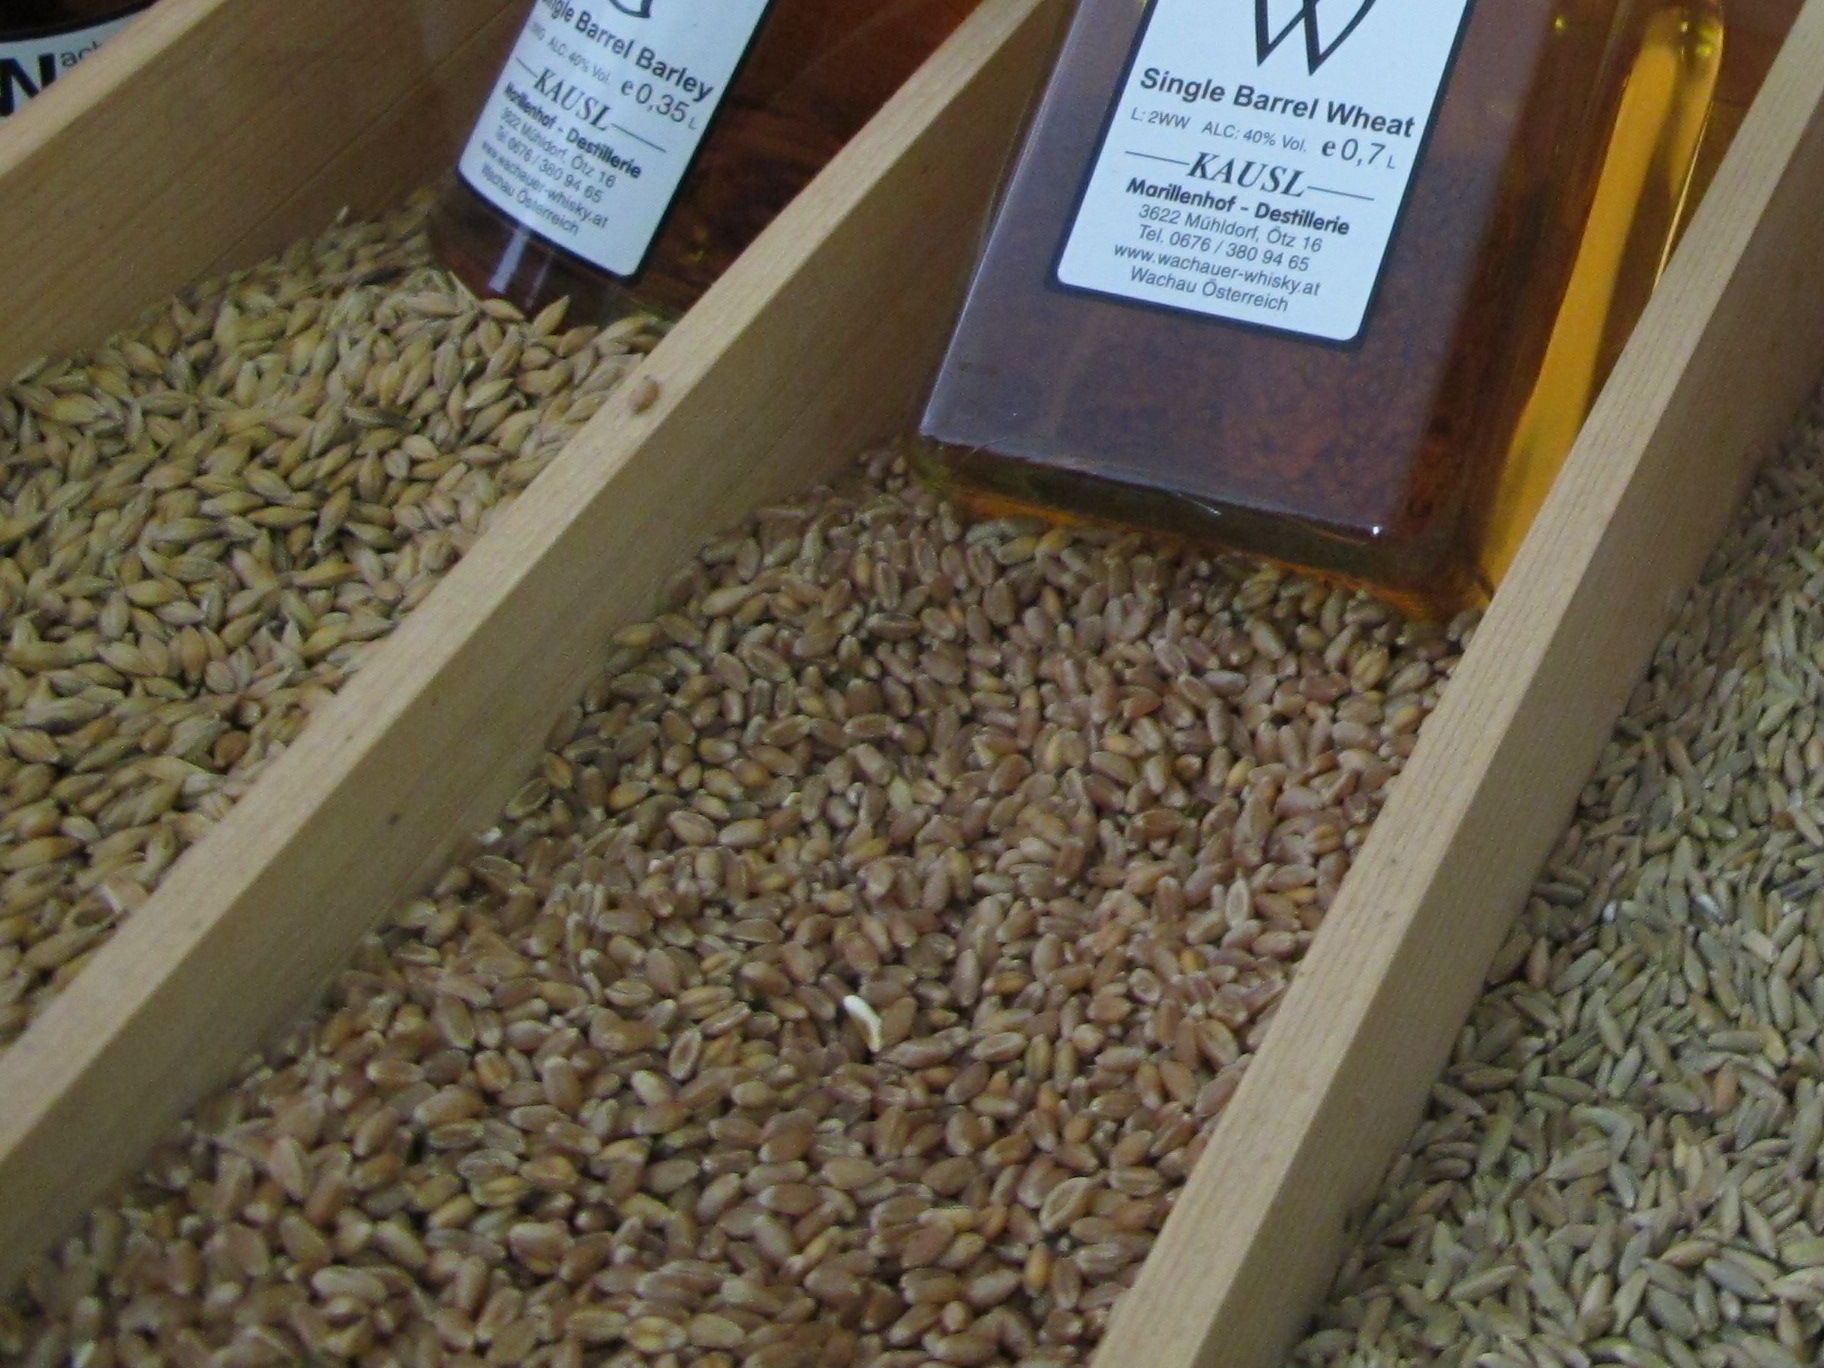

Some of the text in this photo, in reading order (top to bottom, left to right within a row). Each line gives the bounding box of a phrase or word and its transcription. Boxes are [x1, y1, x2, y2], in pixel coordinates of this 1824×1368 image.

[575, 11, 634, 59] Barrel
[636, 46, 716, 103] Barley
[533, 66, 615, 132] KAUSL
[1140, 66, 1416, 138] Single Barrel Wheat
[566, 128, 643, 179] Destillerie
[1148, 110, 1191, 130] 2WW
[1201, 121, 1239, 140] ALC:
[1243, 128, 1276, 147] 40%
[1282, 135, 1307, 153] Vol.
[539, 159, 563, 182] 380
[566, 174, 581, 193] 94
[583, 185, 603, 204] 65
[600, 171, 617, 189] 16
[1186, 151, 1306, 198] KAUSL
[1125, 177, 1237, 213] Marillenhof
[1254, 202, 1350, 235] Destillerie
[1138, 204, 1181, 225] 3622
[1266, 228, 1296, 248] Ötz
[1302, 237, 1323, 253] 16
[1113, 243, 1321, 297] www.wachauer-whisky.at
[1138, 224, 1164, 243] Tel.
[1169, 232, 1211, 253] 0676
[1225, 242, 1259, 262] 380
[1262, 251, 1283, 267] 94
[1288, 256, 1310, 272] 65
[1129, 266, 1289, 313] Wachau Österreich
